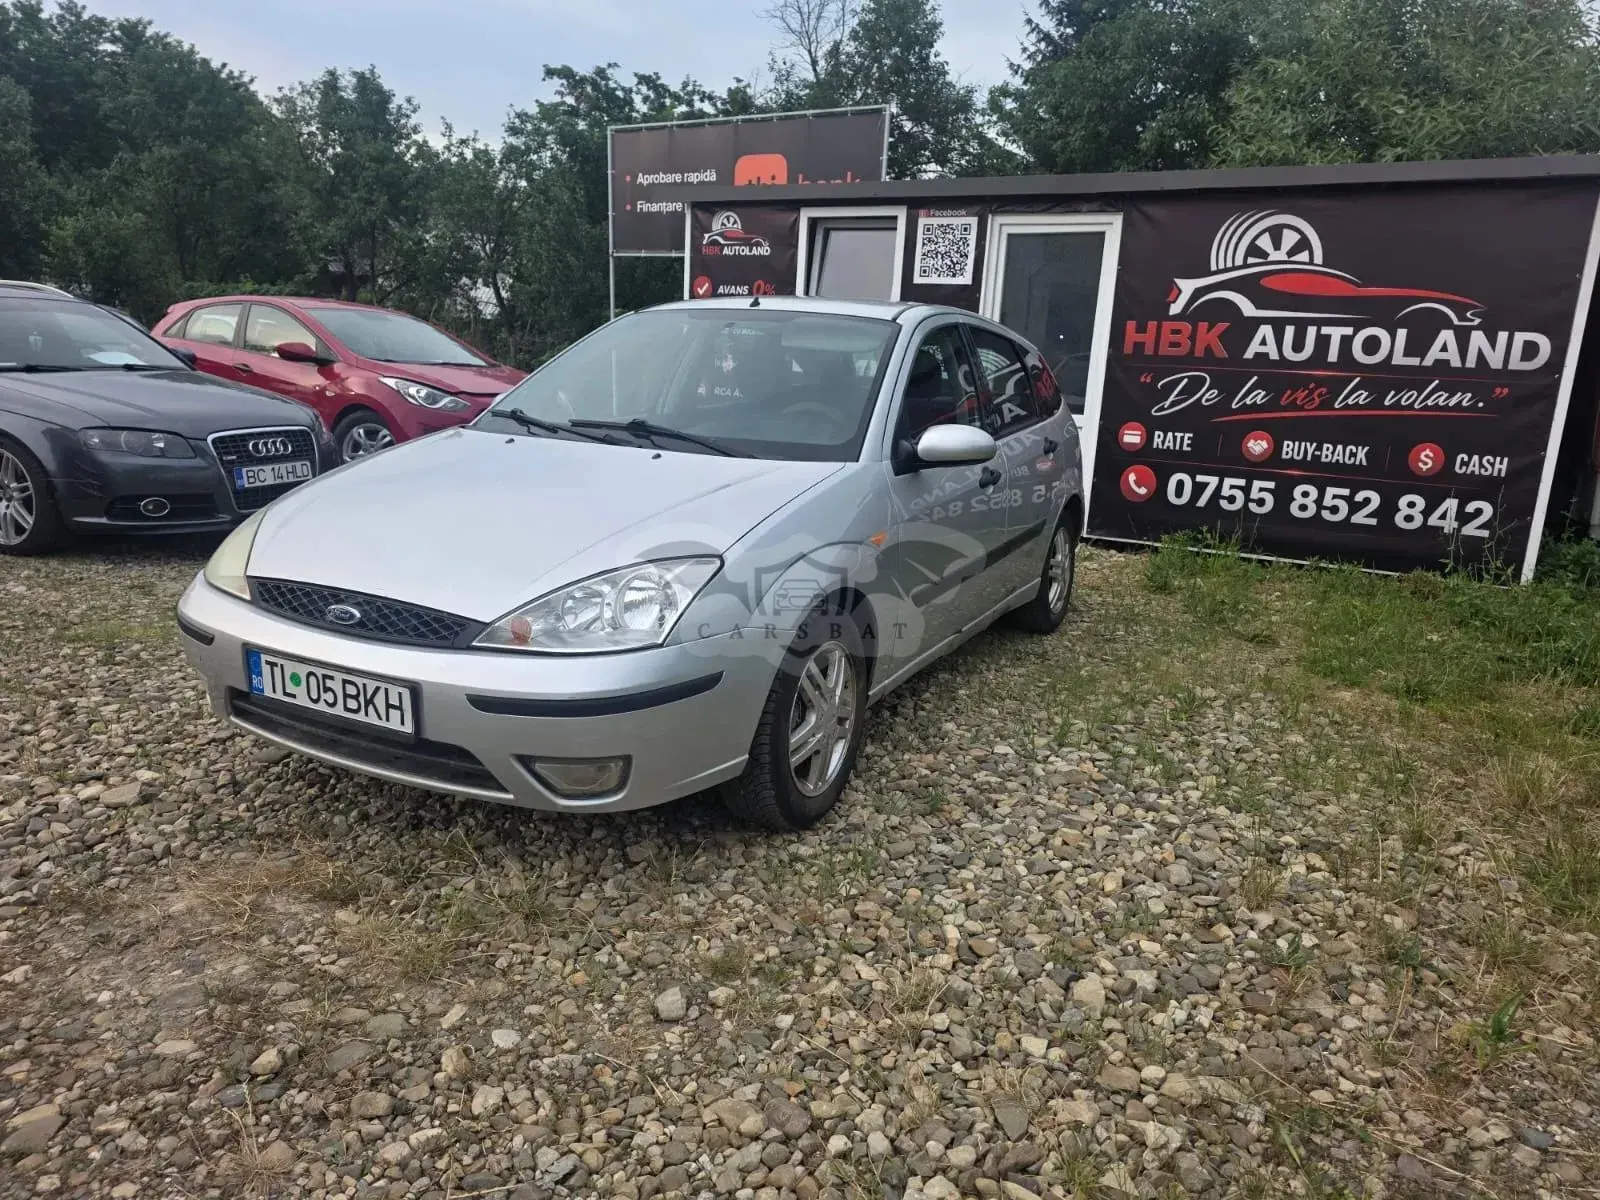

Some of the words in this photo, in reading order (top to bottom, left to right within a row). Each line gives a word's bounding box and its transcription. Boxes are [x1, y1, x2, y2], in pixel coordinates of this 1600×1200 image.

[636, 171, 682, 187] Aprobare
[684, 169, 717, 184] rapidă
[637, 200, 682, 215] Finanțare
[930, 208, 968, 217] Facebook
[702, 244, 721, 255] HBK
[722, 245, 771, 256] AUTOLAND
[717, 285, 749, 295] AVANS
[753, 279, 776, 295] 0%
[1123, 320, 1232, 359] HBK
[1242, 324, 1552, 371] AUTOLAND
[1231, 375, 1272, 408] la
[1279, 381, 1329, 408] vis
[1334, 376, 1376, 409] la
[1152, 430, 1193, 452] RATE
[1281, 440, 1369, 466] BUY-BACK
[246, 469, 267, 485] BC
[271, 466, 284, 482] 14
[285, 463, 310, 481] HLD
[1454, 453, 1509, 478] CASH
[1166, 472, 1277, 514] 0755
[1289, 484, 1381, 525] 852
[1394, 495, 1495, 538] 842
[252, 674, 264, 689] RO
